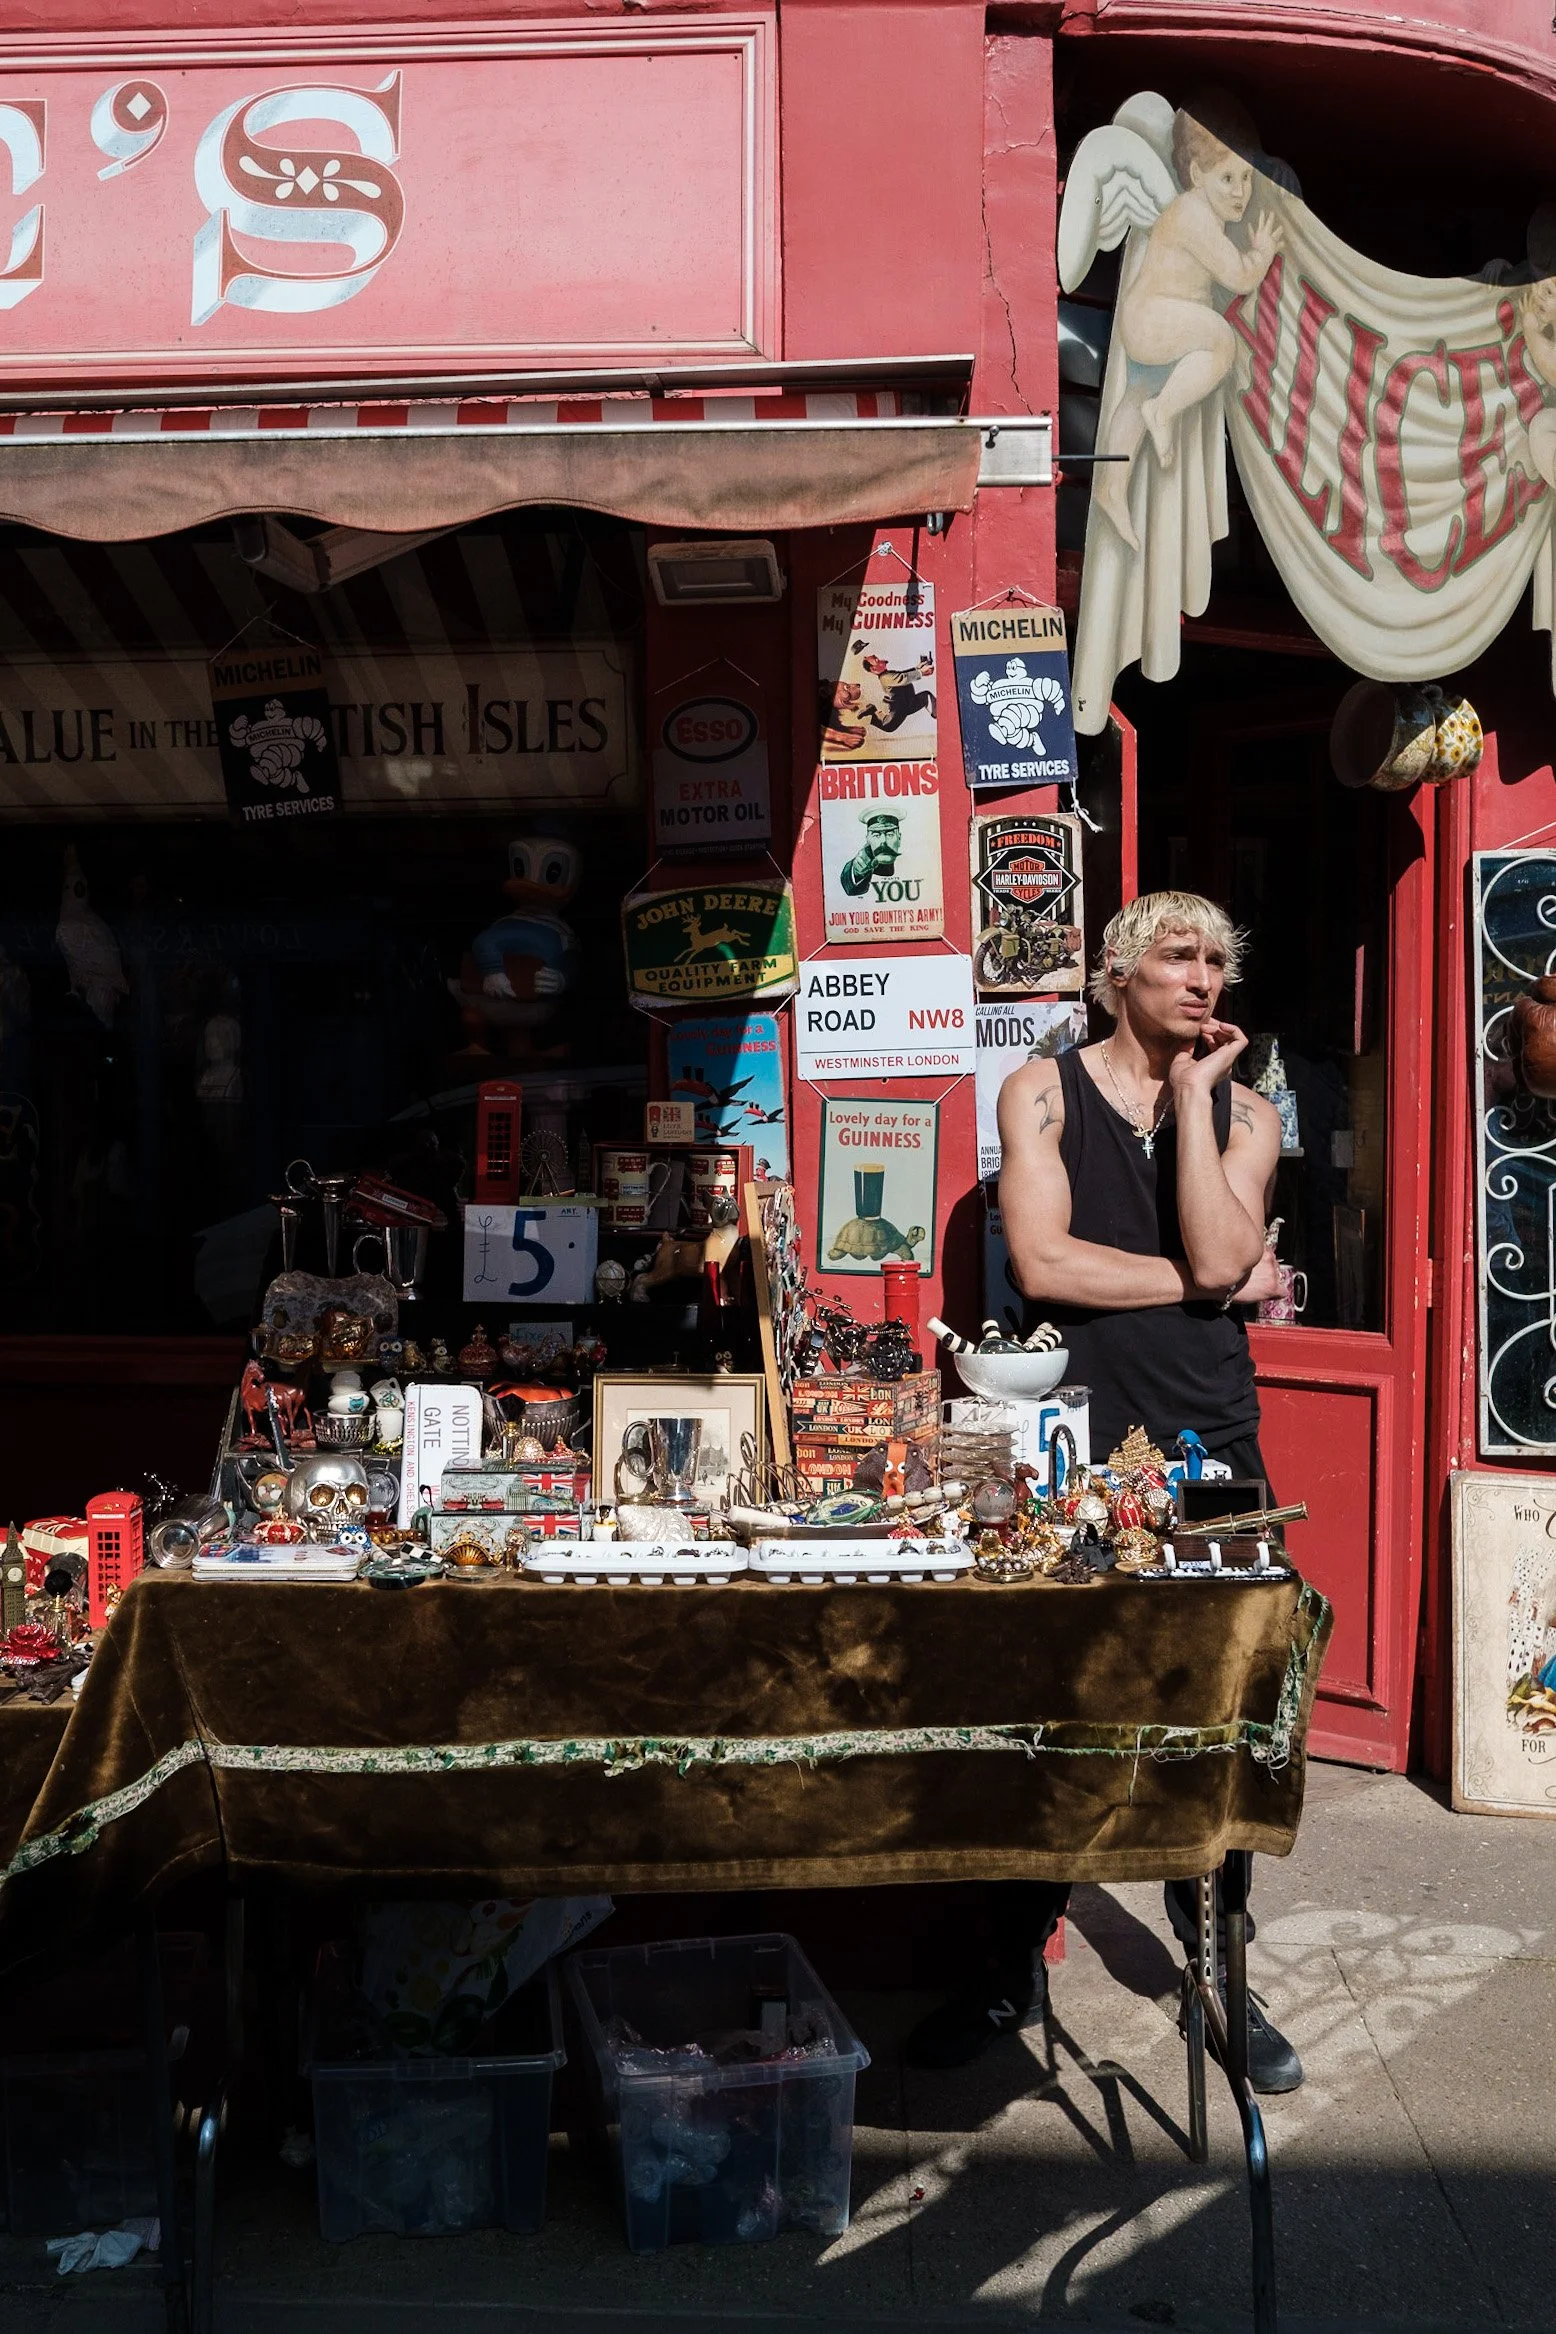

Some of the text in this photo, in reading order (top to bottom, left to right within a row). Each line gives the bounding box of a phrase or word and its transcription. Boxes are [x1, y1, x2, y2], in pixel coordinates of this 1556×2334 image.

[0, 69, 405, 326] 'S
[831, 591, 925, 612] My Goodness
[822, 611, 935, 636] My GUINNESS
[959, 617, 1064, 642] MICHELIN
[213, 655, 322, 688] MICHELIN
[989, 688, 1031, 700] MICHELIN
[0, 708, 117, 764] ALUE
[130, 721, 156, 749] IN
[328, 702, 447, 757] TISH
[466, 684, 609, 755] ISLES
[249, 728, 292, 742] MICHELIN
[978, 759, 1070, 781] TYRE SERVICES
[679, 779, 743, 801] EXTRA
[821, 763, 939, 801] BRITONS
[242, 795, 335, 822] TYRE SERVICES
[659, 802, 765, 827] MOTOR OIL
[996, 831, 1055, 849] FREEDOM
[1014, 860, 1040, 871] MOTOR
[995, 873, 1059, 886] HARLEY-DAVIDSON
[1014, 888, 1041, 900] CYCLES
[635, 893, 780, 931] JOHN DEERE
[829, 907, 943, 926] JOIN YOUR COUNTRY'S ARMY!
[844, 926, 859, 934] GOD
[864, 925, 885, 933] SAVE
[645, 958, 777, 982] QUALITY FARM
[659, 971, 767, 993] EQUIPMENT
[808, 973, 890, 998] ABBEY
[808, 1008, 965, 1032] ROAD NW8
[976, 1005, 1015, 1016] CALLING ALL
[976, 1016, 1035, 1049] MODS
[815, 1054, 959, 1070] WESTMINSTER LONDON
[829, 1112, 932, 1127] Lovely day for a
[838, 1128, 921, 1149] GUINNESS
[981, 1157, 1001, 1169] BRIG
[508, 1210, 555, 1297] 5
[798, 1390, 839, 1399] LONDON
[405, 1401, 416, 1456] KENSINGTON
[424, 1406, 442, 1449] GATE
[452, 1404, 470, 1461] NOTTIN
[808, 1424, 839, 1432] LONDON
[848, 1426, 863, 1434] UK
[1035, 1407, 1067, 1498] 5
[406, 1461, 416, 1478] AND
[800, 1463, 852, 1475] LONDON
[1522, 1739, 1546, 1753] FOR
